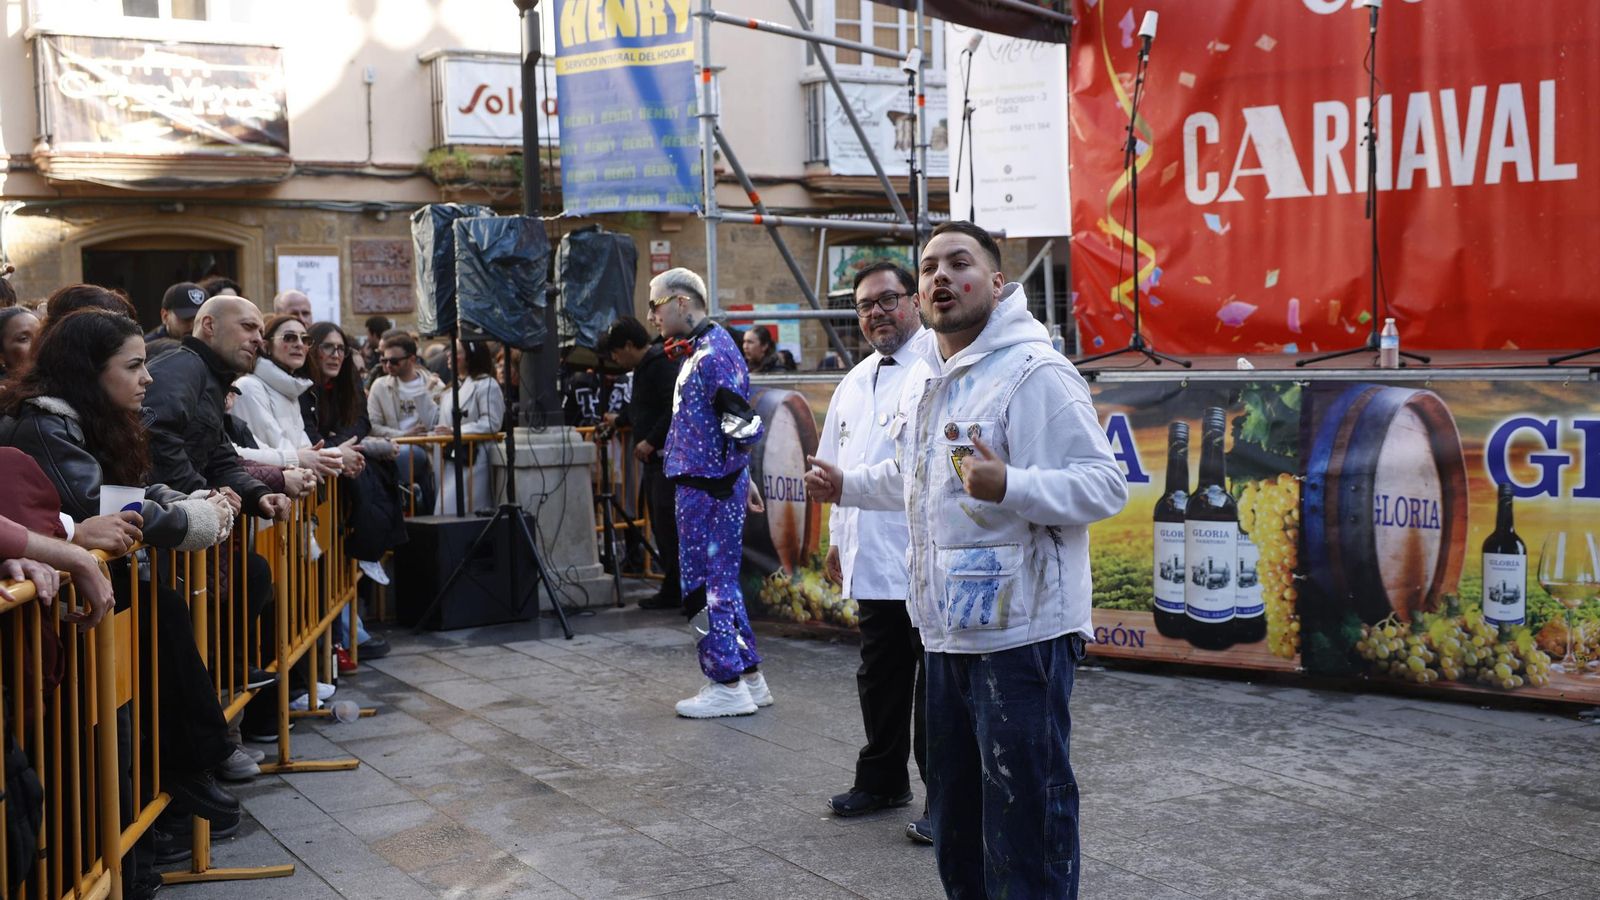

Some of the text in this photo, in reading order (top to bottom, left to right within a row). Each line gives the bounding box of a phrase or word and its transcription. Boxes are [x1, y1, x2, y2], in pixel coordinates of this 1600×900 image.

[560, 0, 691, 48] HENRY
[564, 47, 687, 70] SERVICIO INTEGRAL DEL HOGAR
[458, 84, 559, 116] Sola
[1183, 80, 1578, 205] CARNAVAL
[1192, 529, 1230, 538] GLORIA
